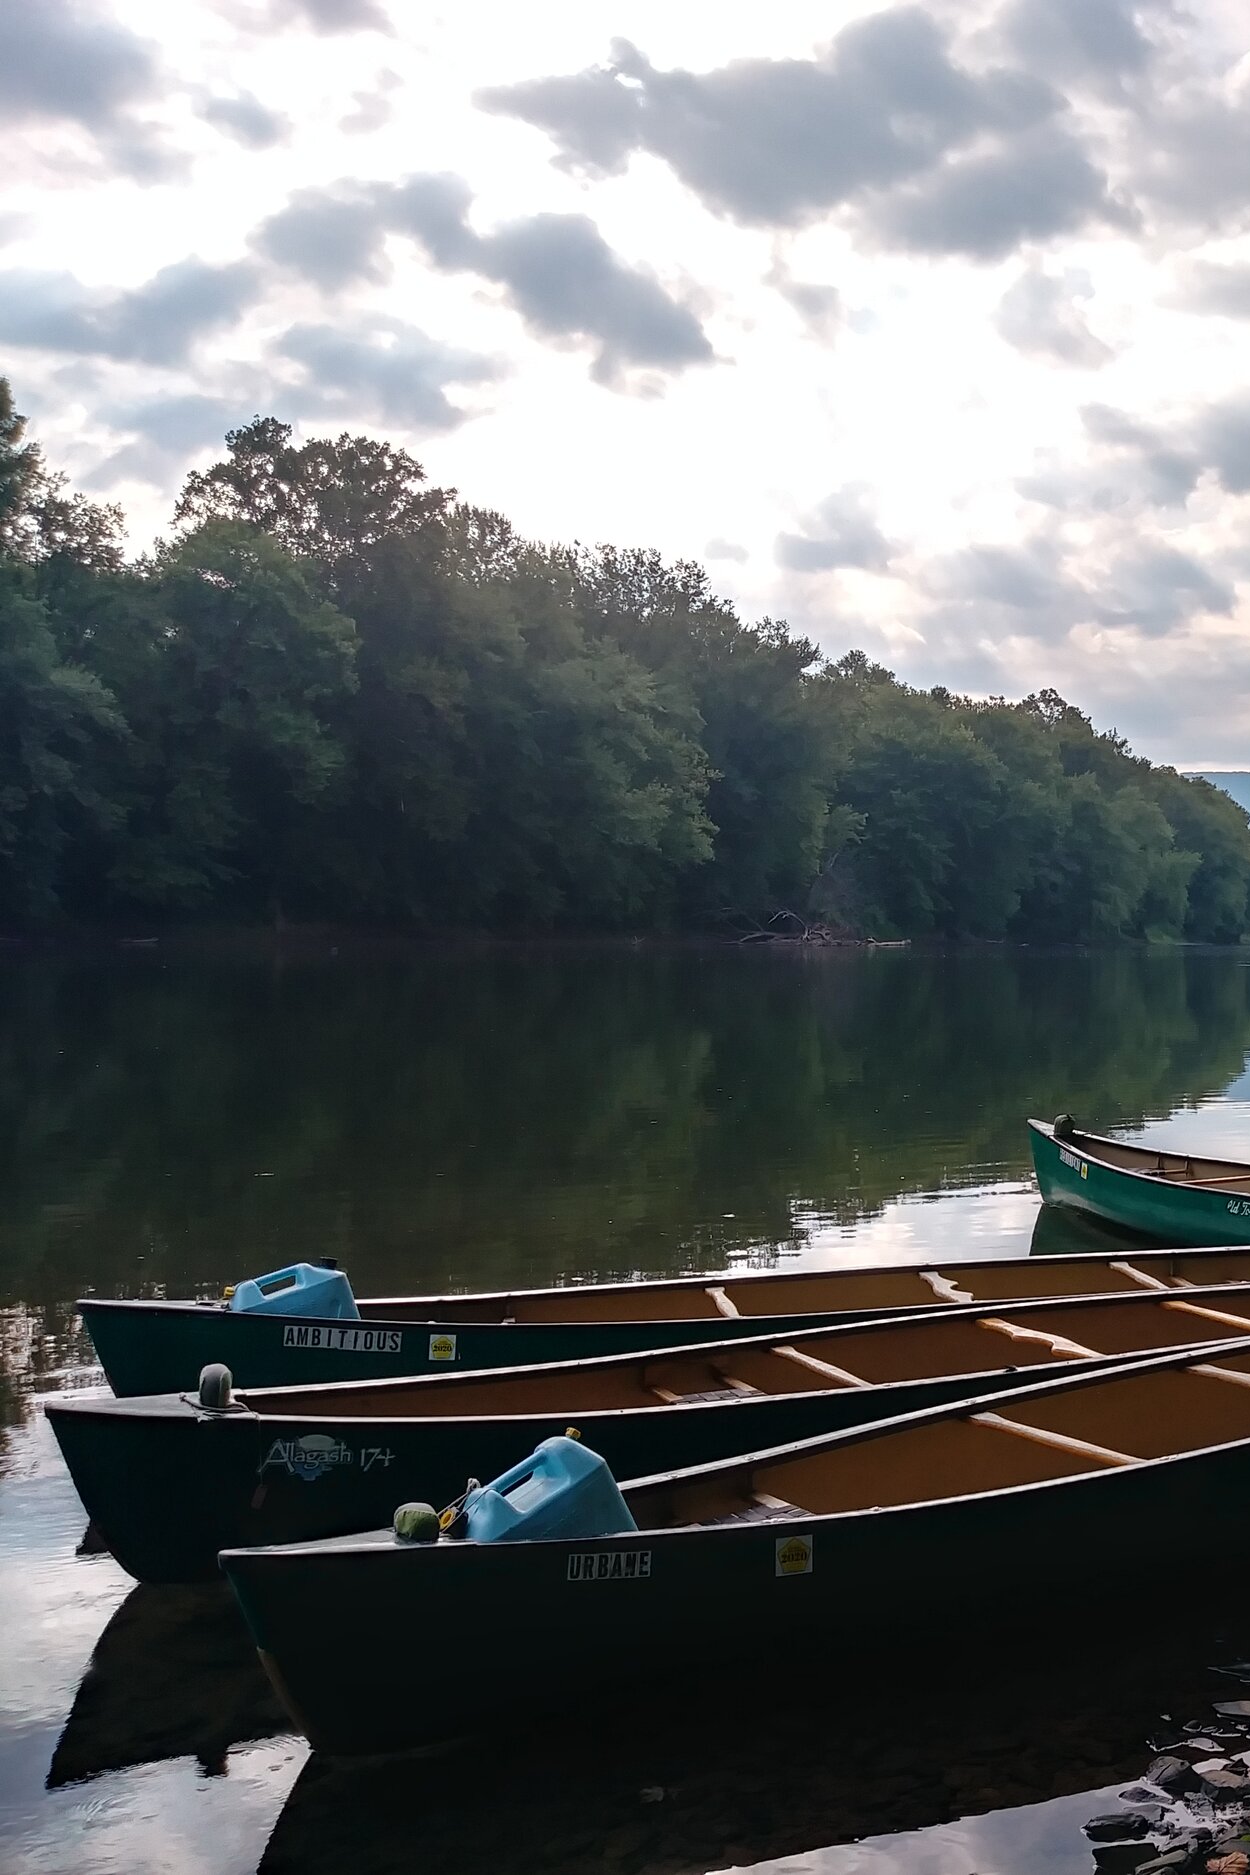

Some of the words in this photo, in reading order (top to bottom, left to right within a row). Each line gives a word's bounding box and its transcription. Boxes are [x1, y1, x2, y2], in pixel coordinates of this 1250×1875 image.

[1227, 1200, 1240, 1214] Old
[284, 1326, 400, 1352] AMBITIOUS
[432, 1343, 453, 1353] 2020
[256, 1437, 352, 1474] Allagash
[569, 1551, 650, 1580] URBANE
[779, 1551, 808, 1564] 2020
